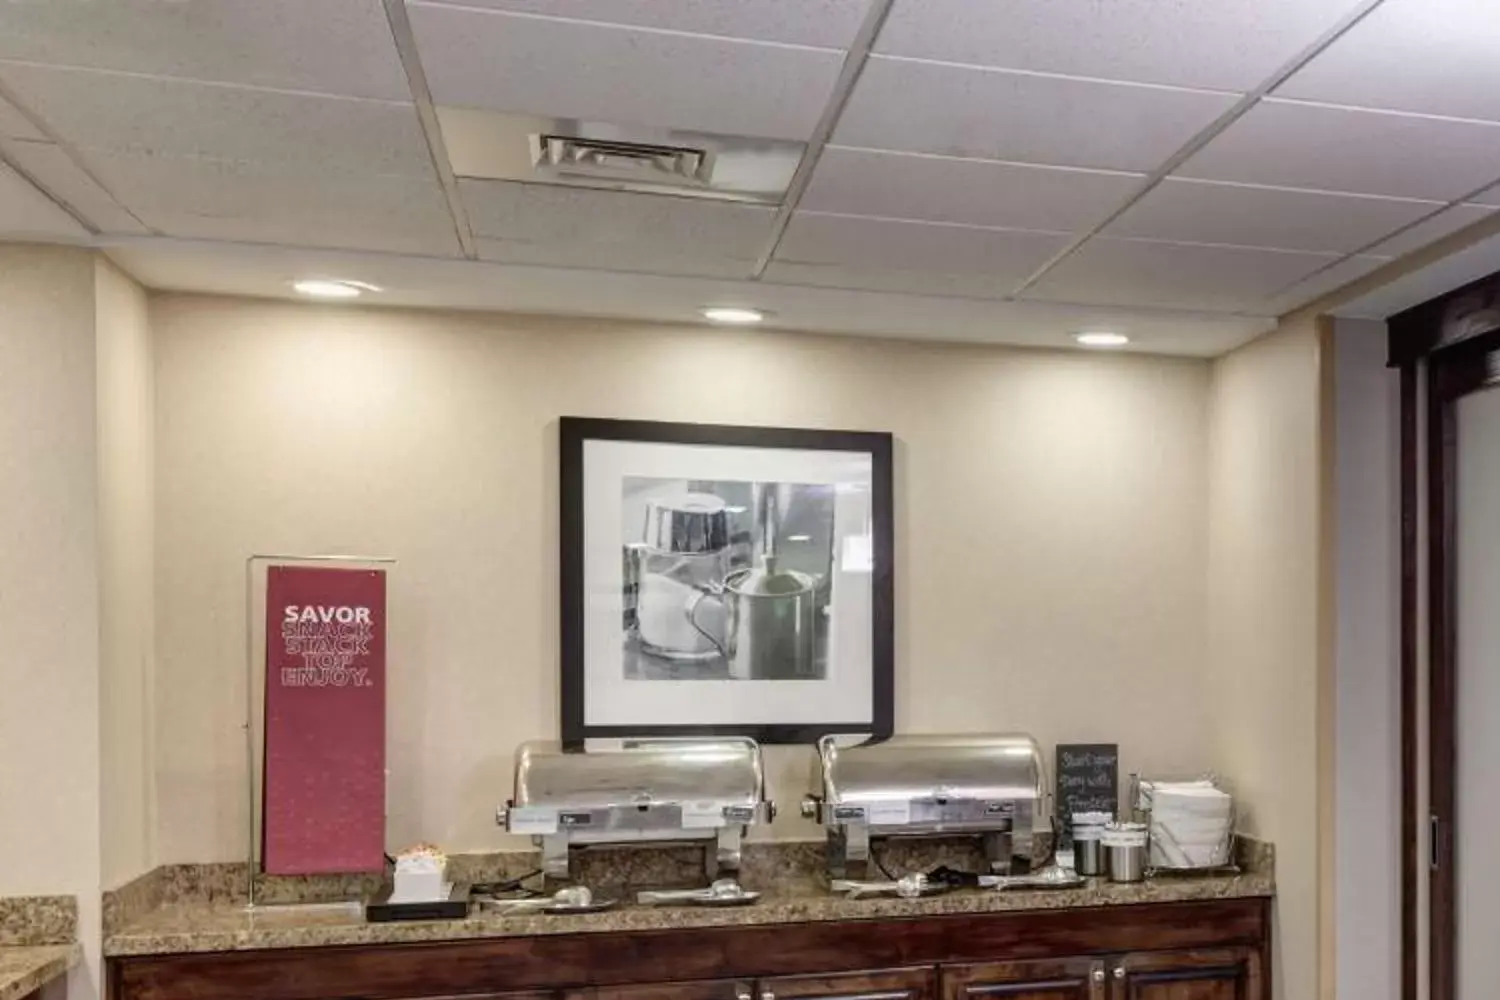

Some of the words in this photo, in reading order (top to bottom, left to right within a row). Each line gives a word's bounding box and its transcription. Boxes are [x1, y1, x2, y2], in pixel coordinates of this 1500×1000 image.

[284, 605, 371, 623] SAVOR
[281, 620, 374, 639] SNACK
[285, 635, 371, 655] STACK
[301, 651, 353, 671] TOP
[281, 667, 373, 687] ENJOY.
